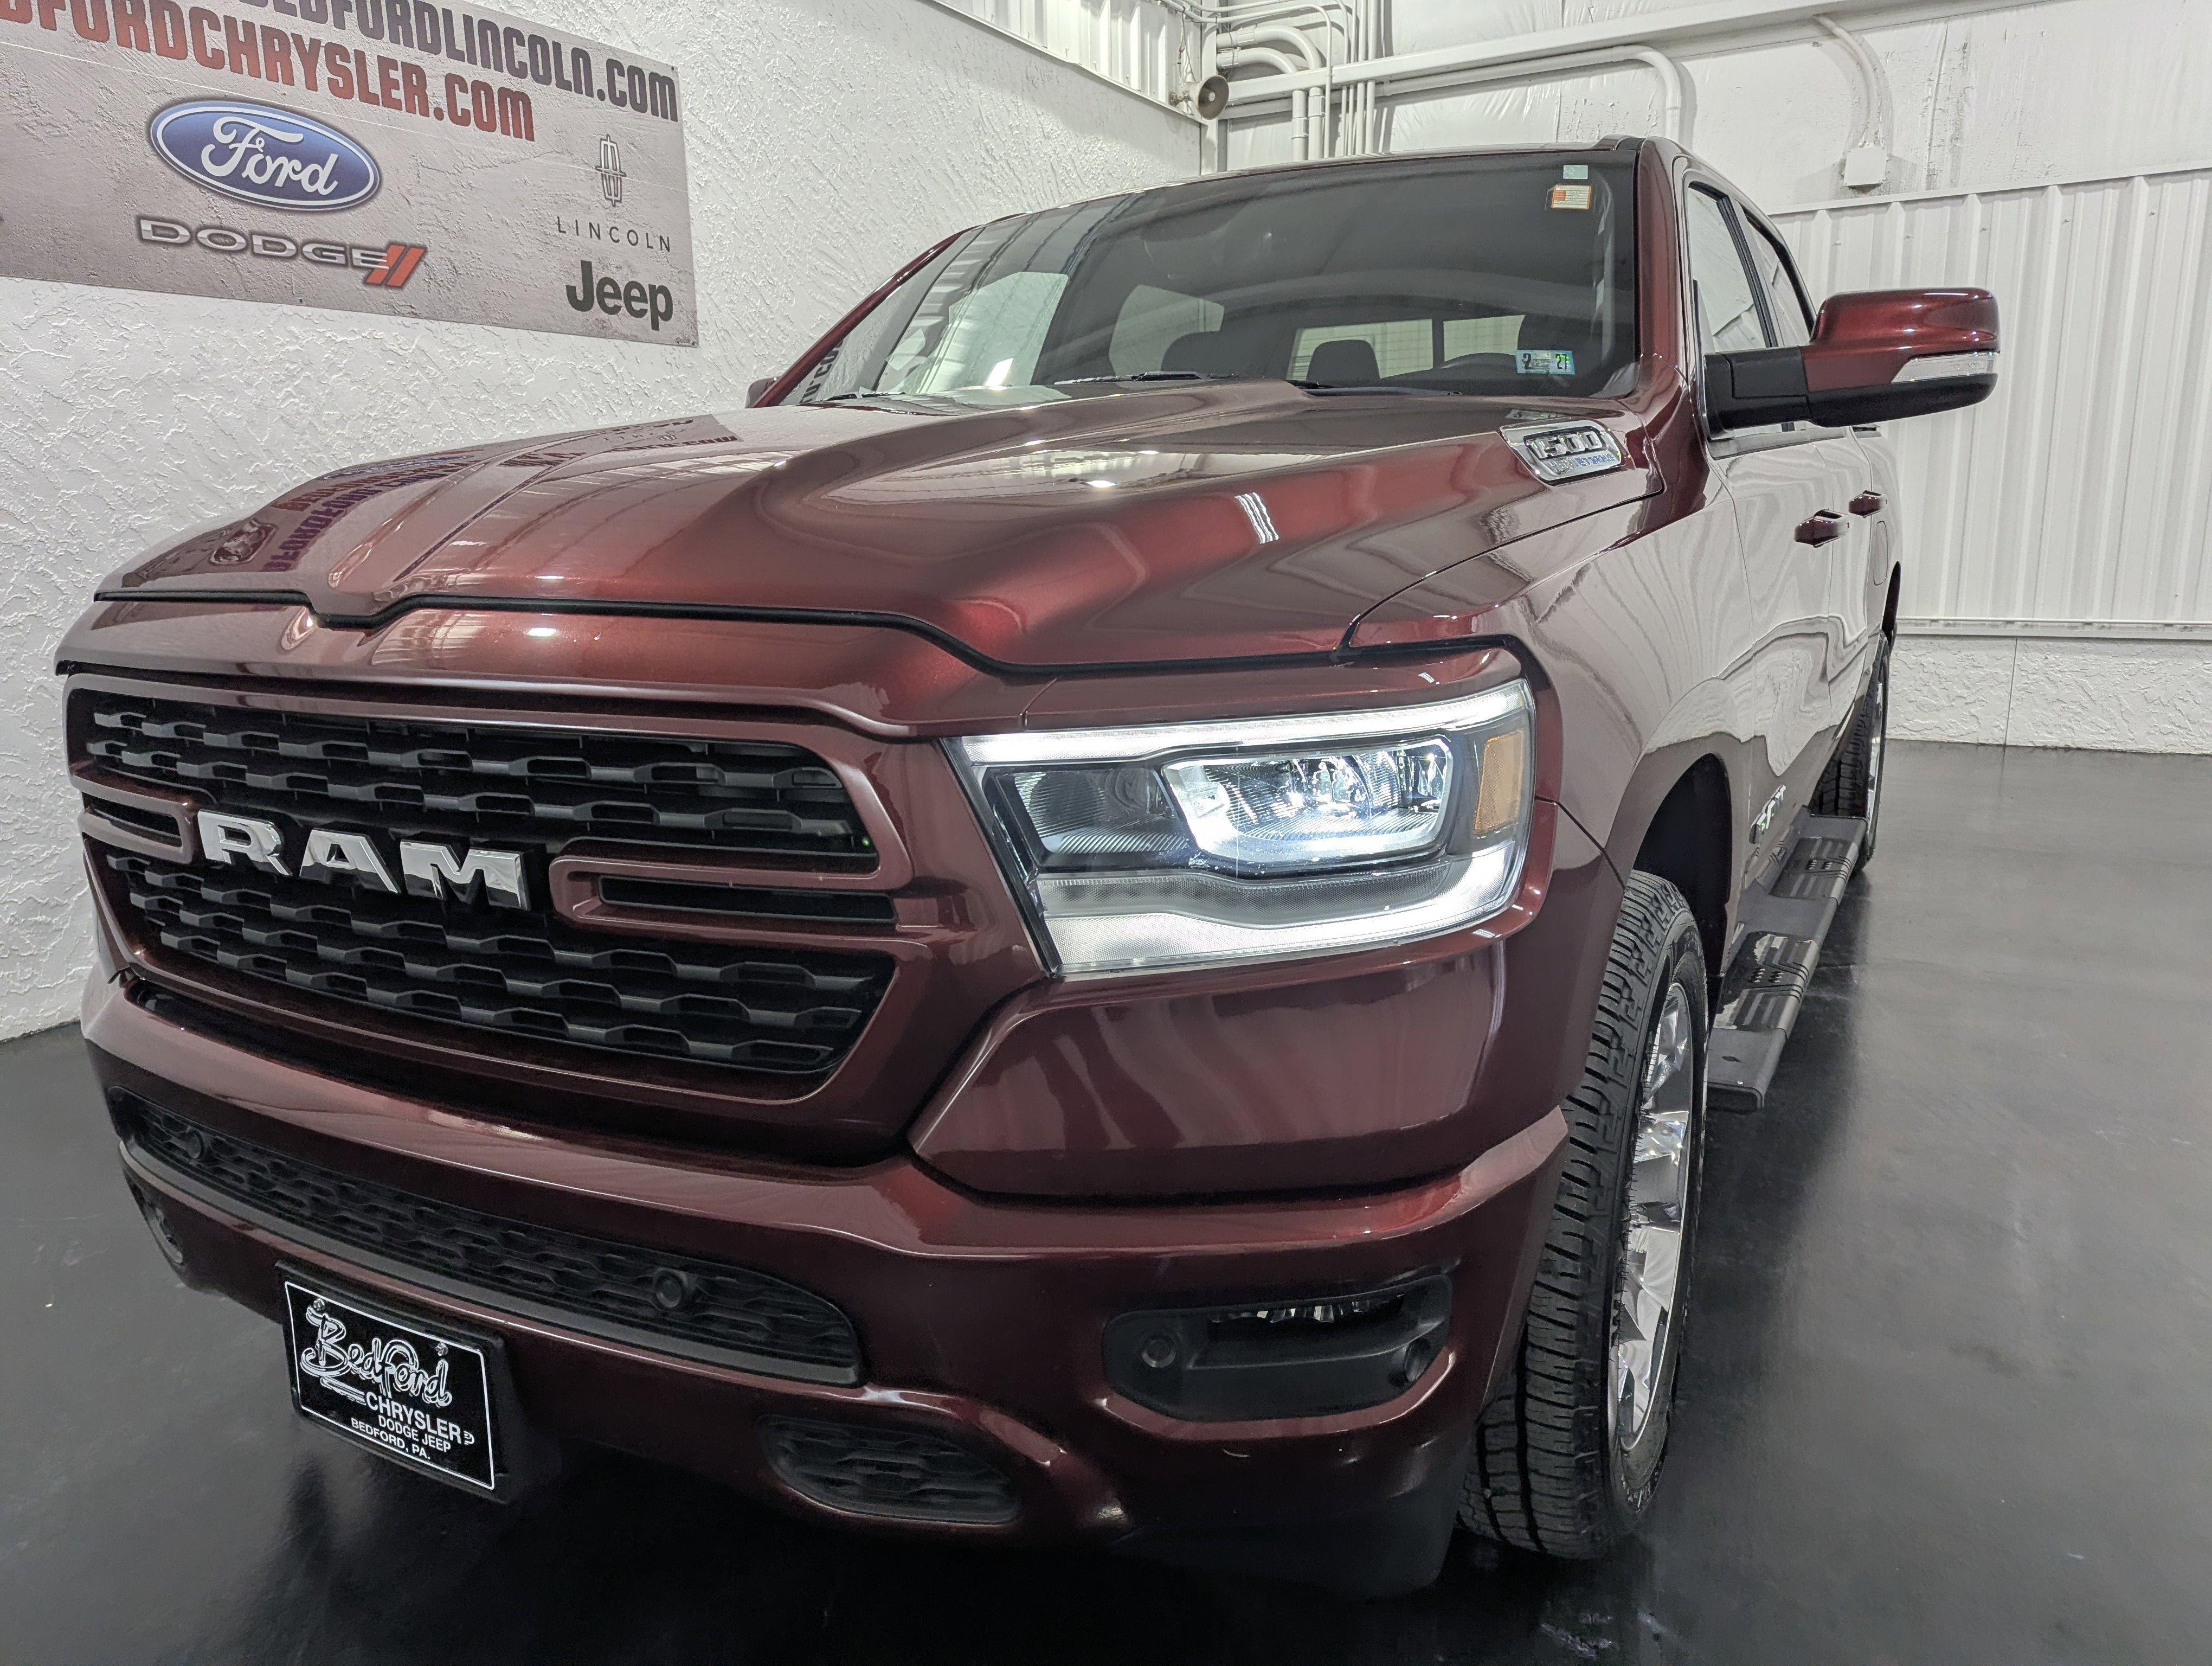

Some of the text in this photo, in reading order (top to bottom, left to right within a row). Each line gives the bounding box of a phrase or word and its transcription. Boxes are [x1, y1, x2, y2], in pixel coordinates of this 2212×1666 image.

[201, 116, 338, 196] Ford
[139, 219, 390, 270] DODGE
[556, 216, 671, 253] LINCOLN
[565, 259, 673, 331] Jeep
[197, 809, 532, 912] RAM
[300, 1305, 453, 1408] Bedford
[350, 1417, 431, 1460] BEDFORD, PA.
[366, 1391, 461, 1444] CHRYSLER
[378, 1414, 451, 1453] DODGE JEEP
